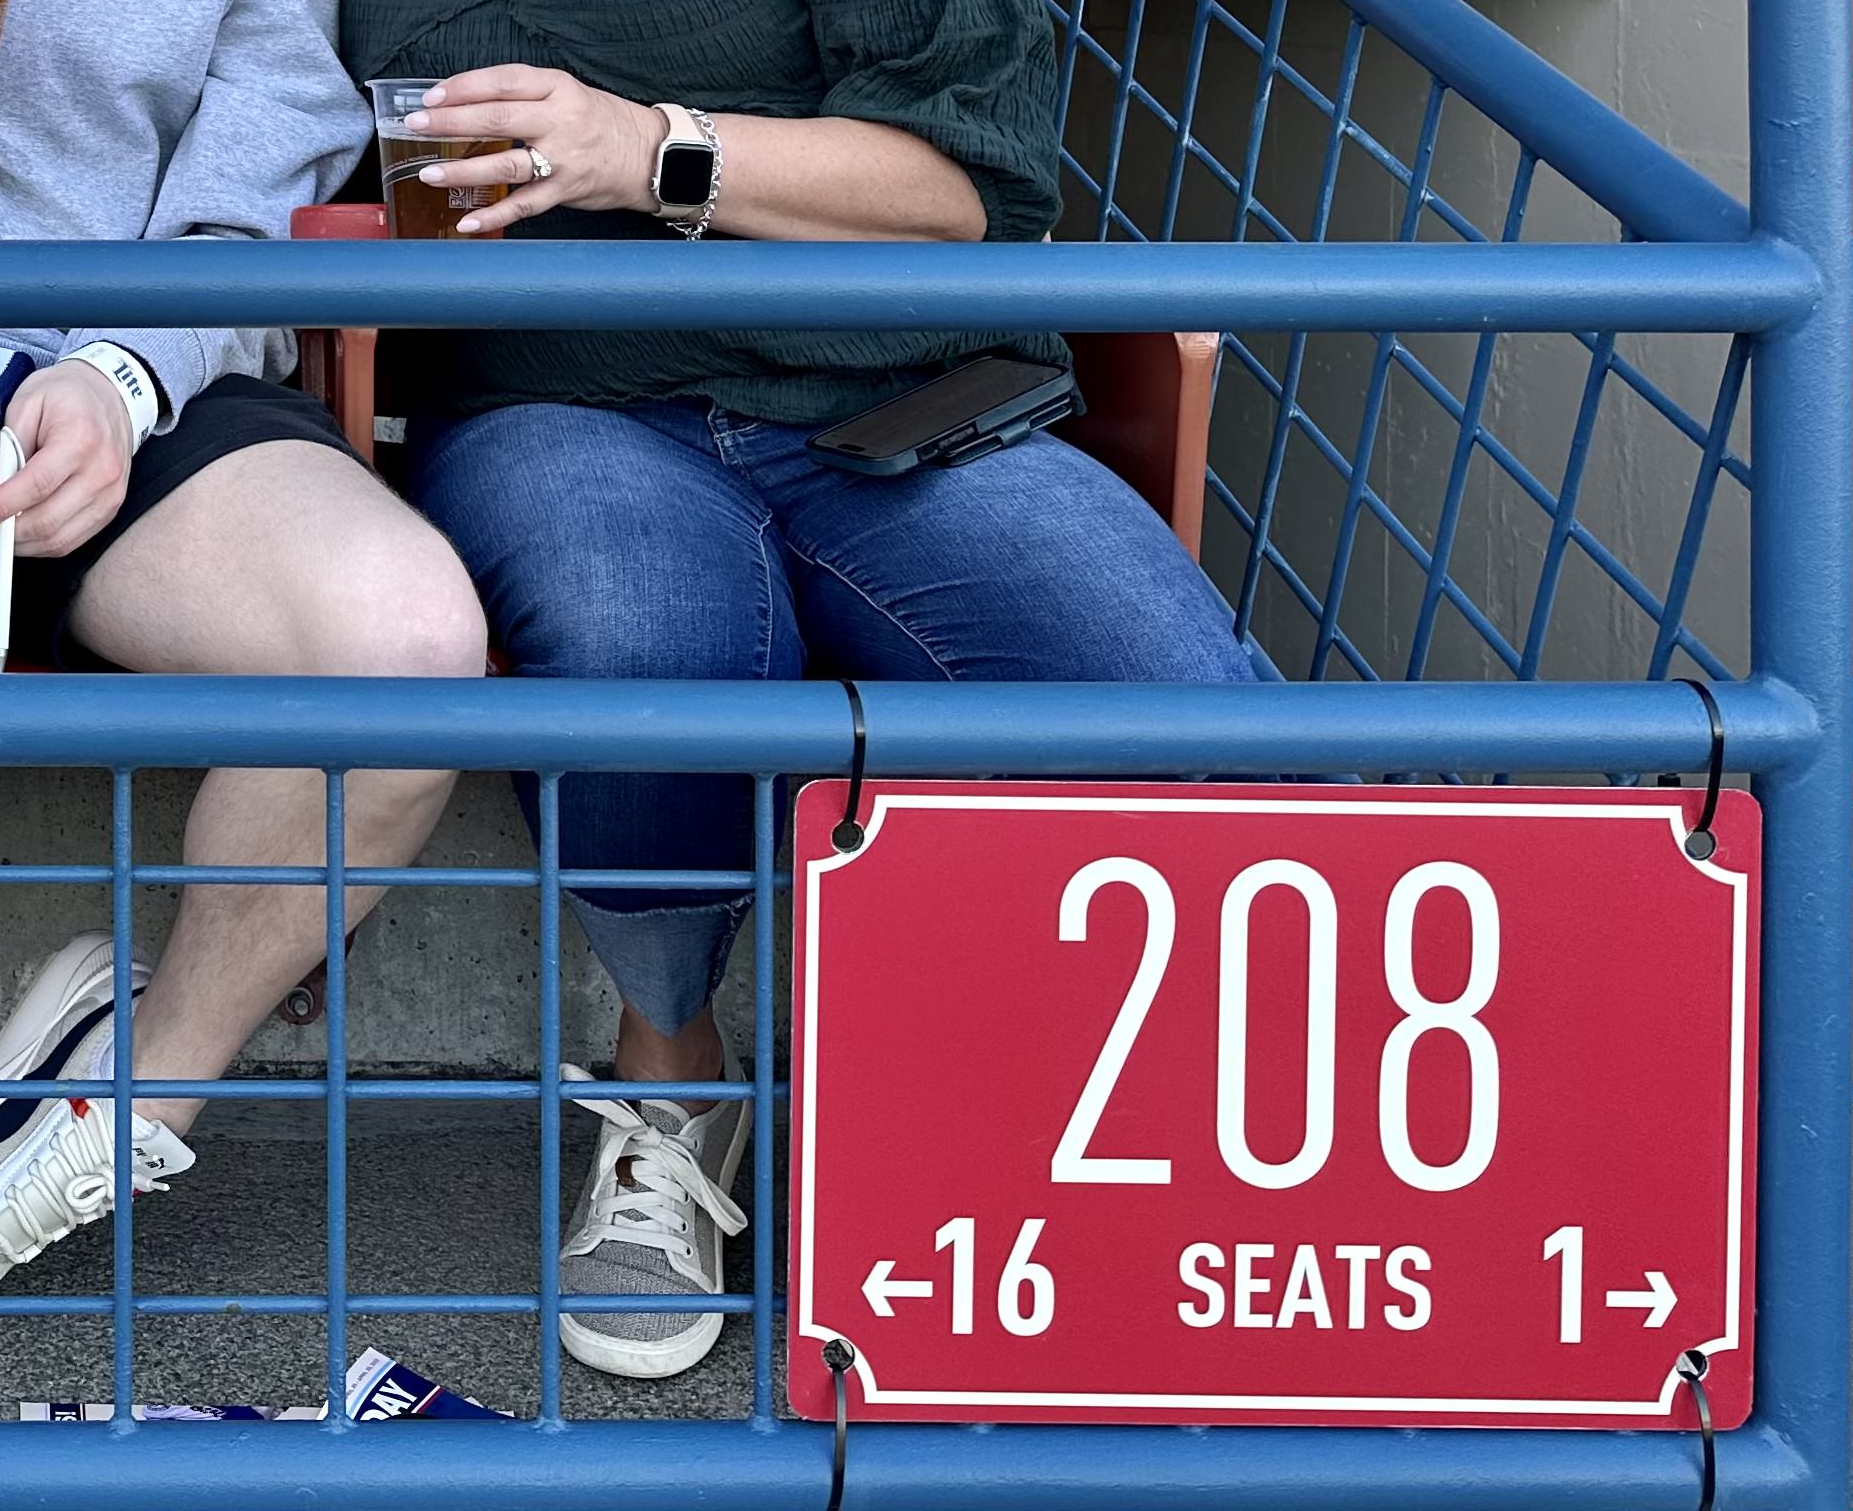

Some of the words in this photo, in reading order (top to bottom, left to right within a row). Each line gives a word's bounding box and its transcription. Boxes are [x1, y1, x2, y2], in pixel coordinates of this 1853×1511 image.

[1049, 855, 1502, 1193] 208
[933, 1216, 1057, 1337] 16
[1176, 1242, 1434, 1332] SEATS
[1542, 1225, 1586, 1344] 1
